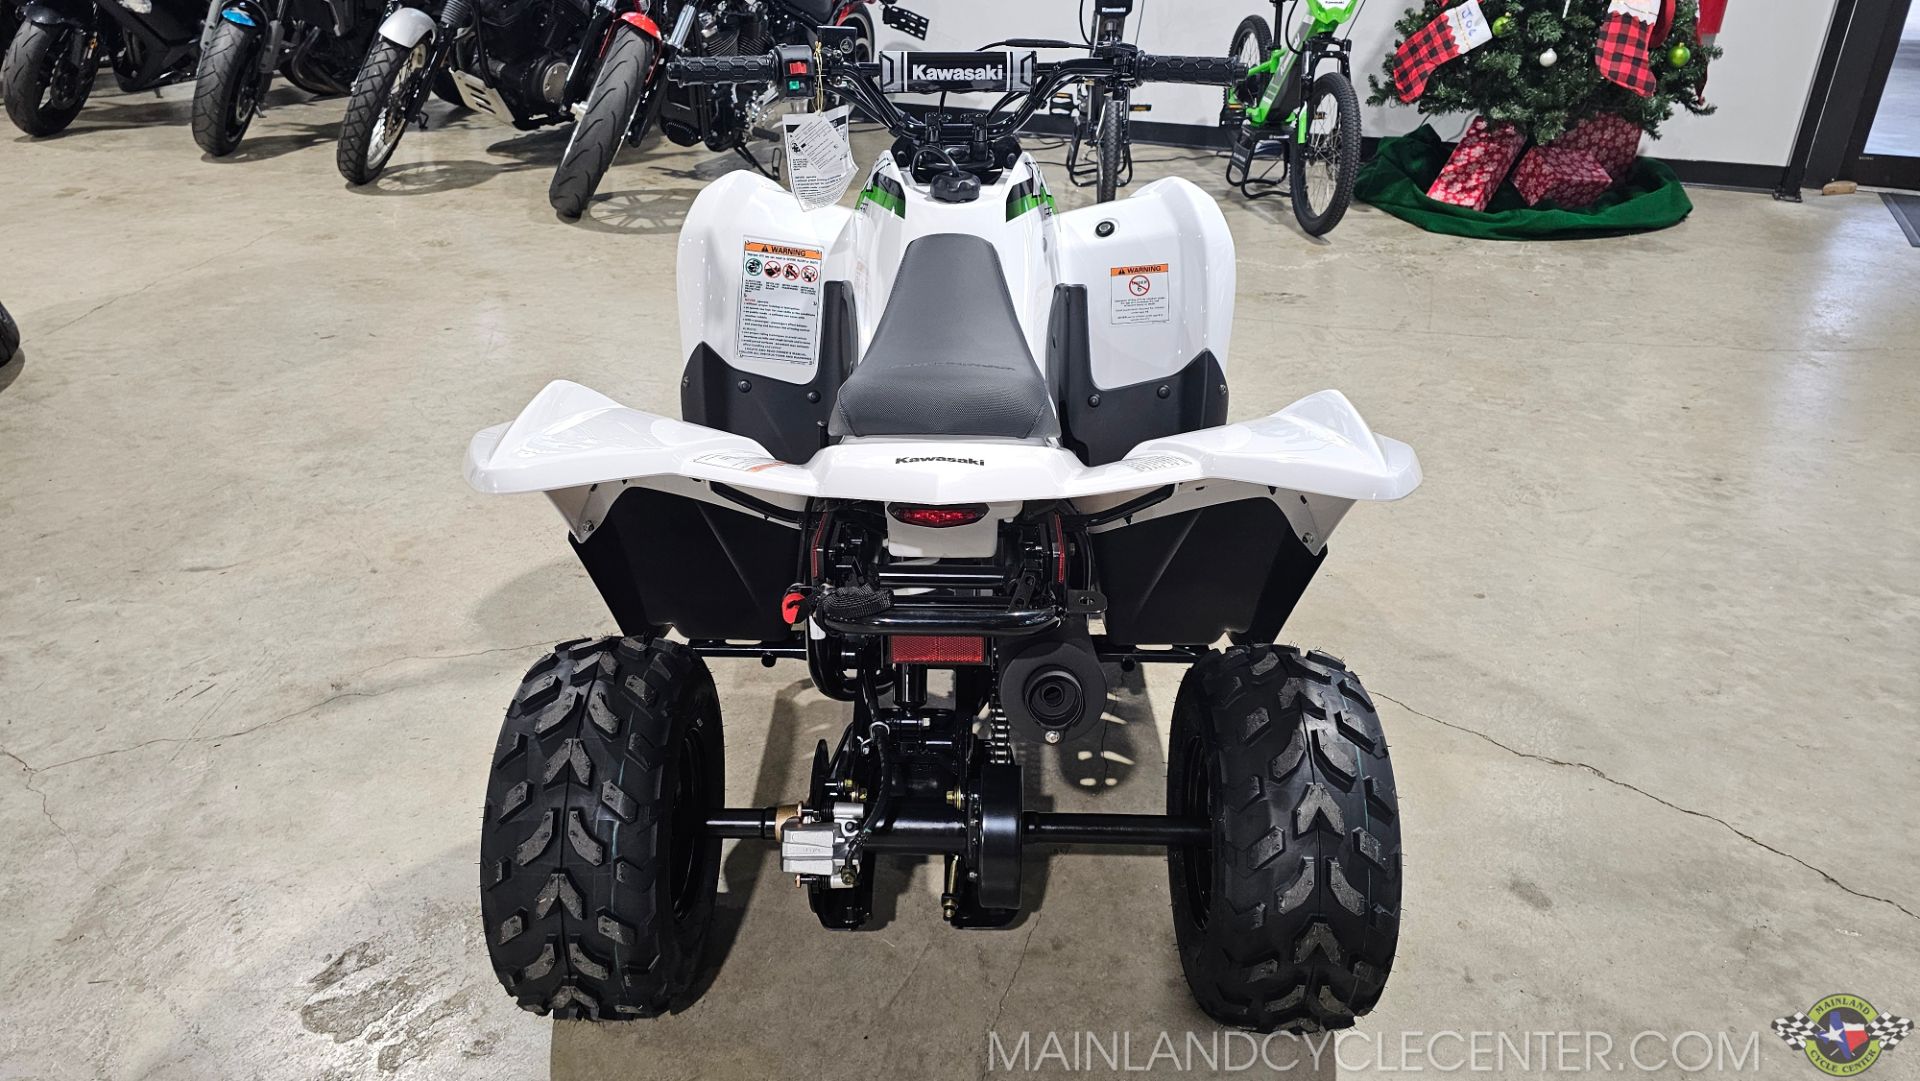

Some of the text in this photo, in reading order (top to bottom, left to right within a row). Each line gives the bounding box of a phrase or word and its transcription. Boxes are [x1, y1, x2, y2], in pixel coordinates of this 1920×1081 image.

[912, 64, 1003, 81] Kawasaki
[771, 246, 806, 257] WARNING
[1127, 265, 1161, 274] WARNING
[895, 456, 985, 466] Kawasaki
